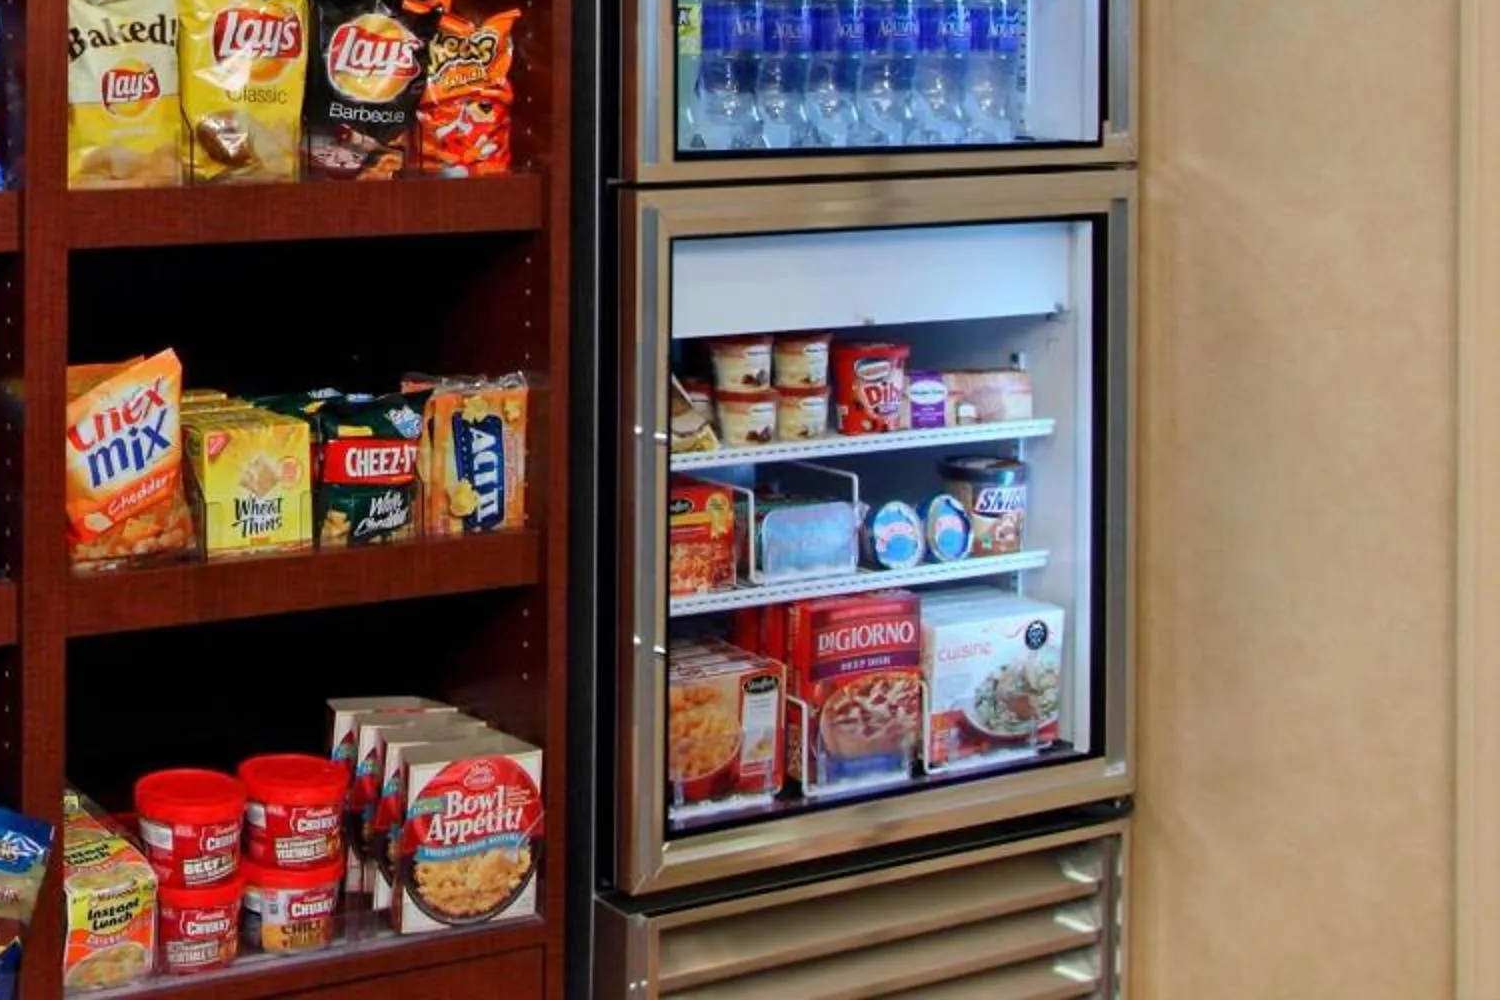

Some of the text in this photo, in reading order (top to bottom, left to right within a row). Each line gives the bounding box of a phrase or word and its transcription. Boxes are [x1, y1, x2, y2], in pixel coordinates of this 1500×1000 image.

[220, 10, 298, 57] Lay's
[334, 25, 422, 73] Lay's
[107, 69, 156, 101] Lay's
[227, 87, 288, 104] Classic
[329, 103, 405, 123] Barbecue
[86, 409, 170, 488] mix
[233, 497, 283, 519] Wheat
[232, 515, 283, 538] Thins
[444, 785, 505, 819] Bowl
[88, 897, 139, 921] Instant
[93, 911, 133, 931] Lunch
